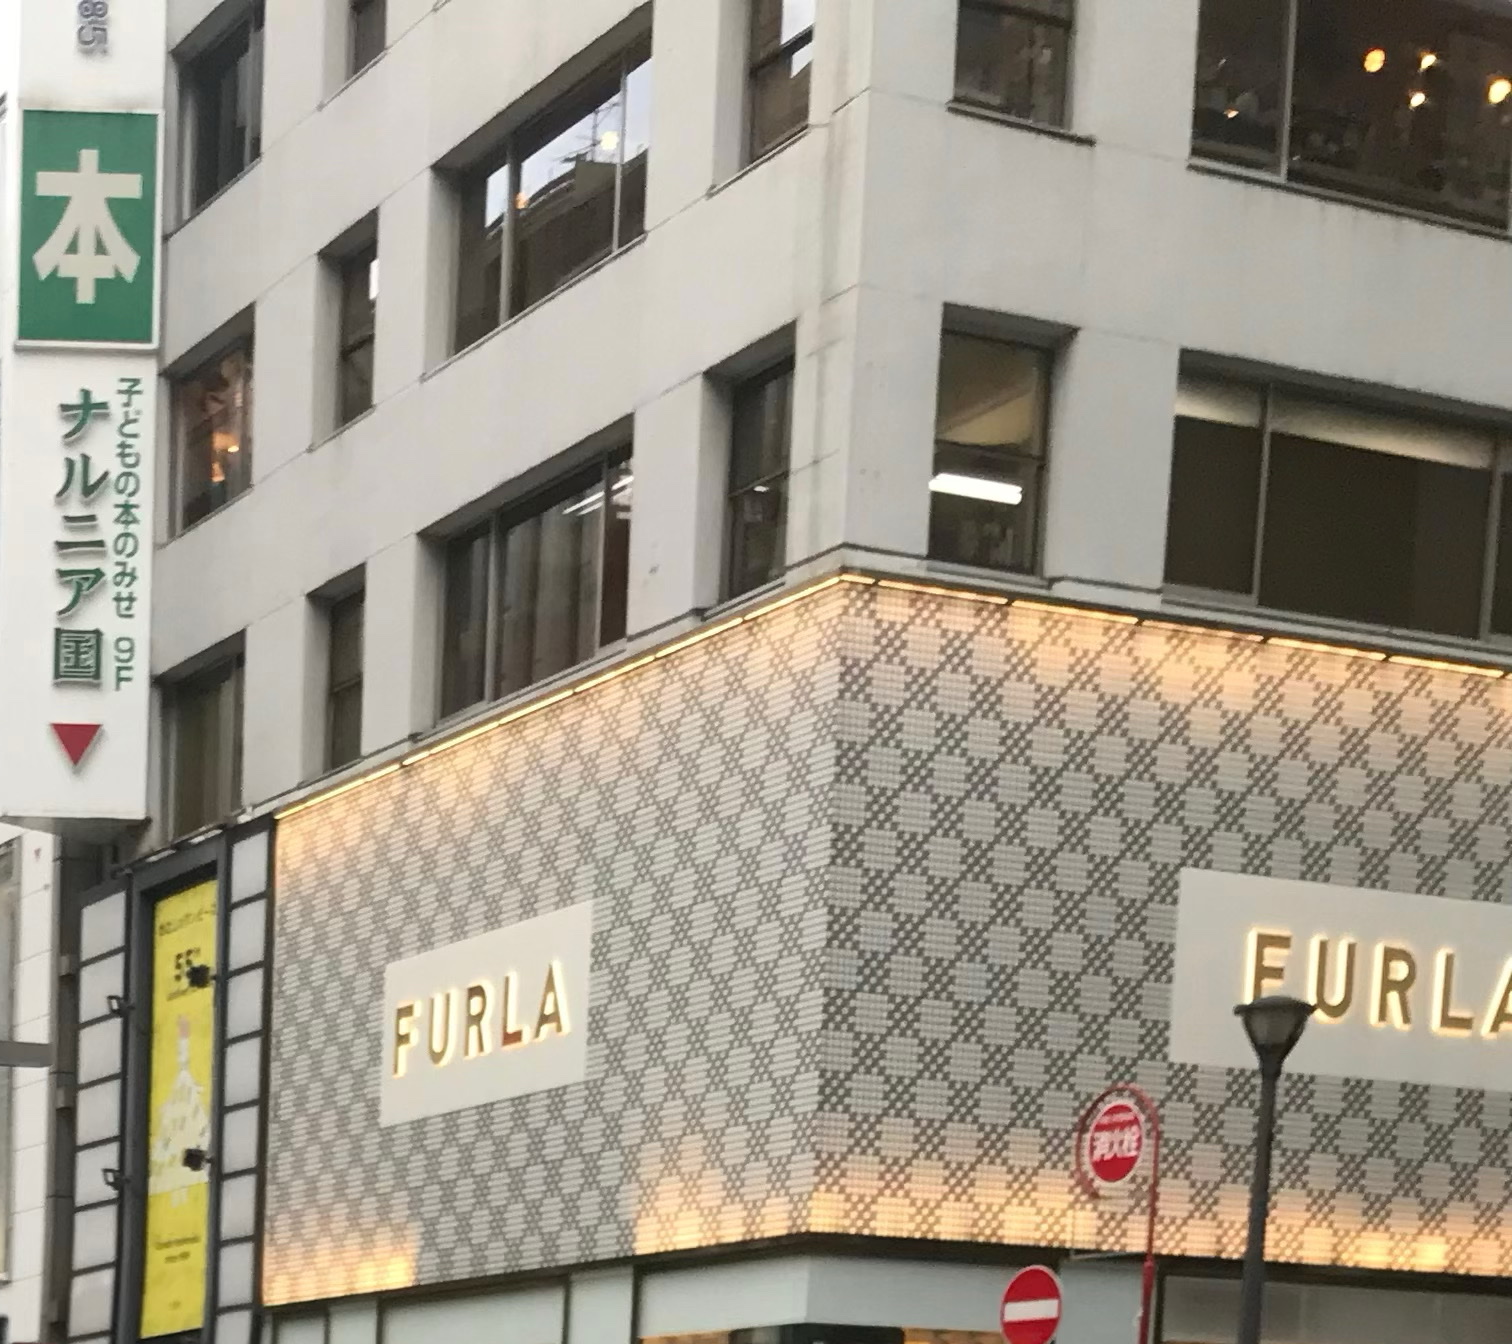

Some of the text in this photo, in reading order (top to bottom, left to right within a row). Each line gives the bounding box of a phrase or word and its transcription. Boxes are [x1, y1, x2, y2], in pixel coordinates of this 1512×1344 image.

[32, 148, 144, 305] 本
[52, 387, 111, 682] ナルニア国
[111, 376, 144, 692] 子どもの本のみせ 9F
[392, 958, 571, 1079] FURLA
